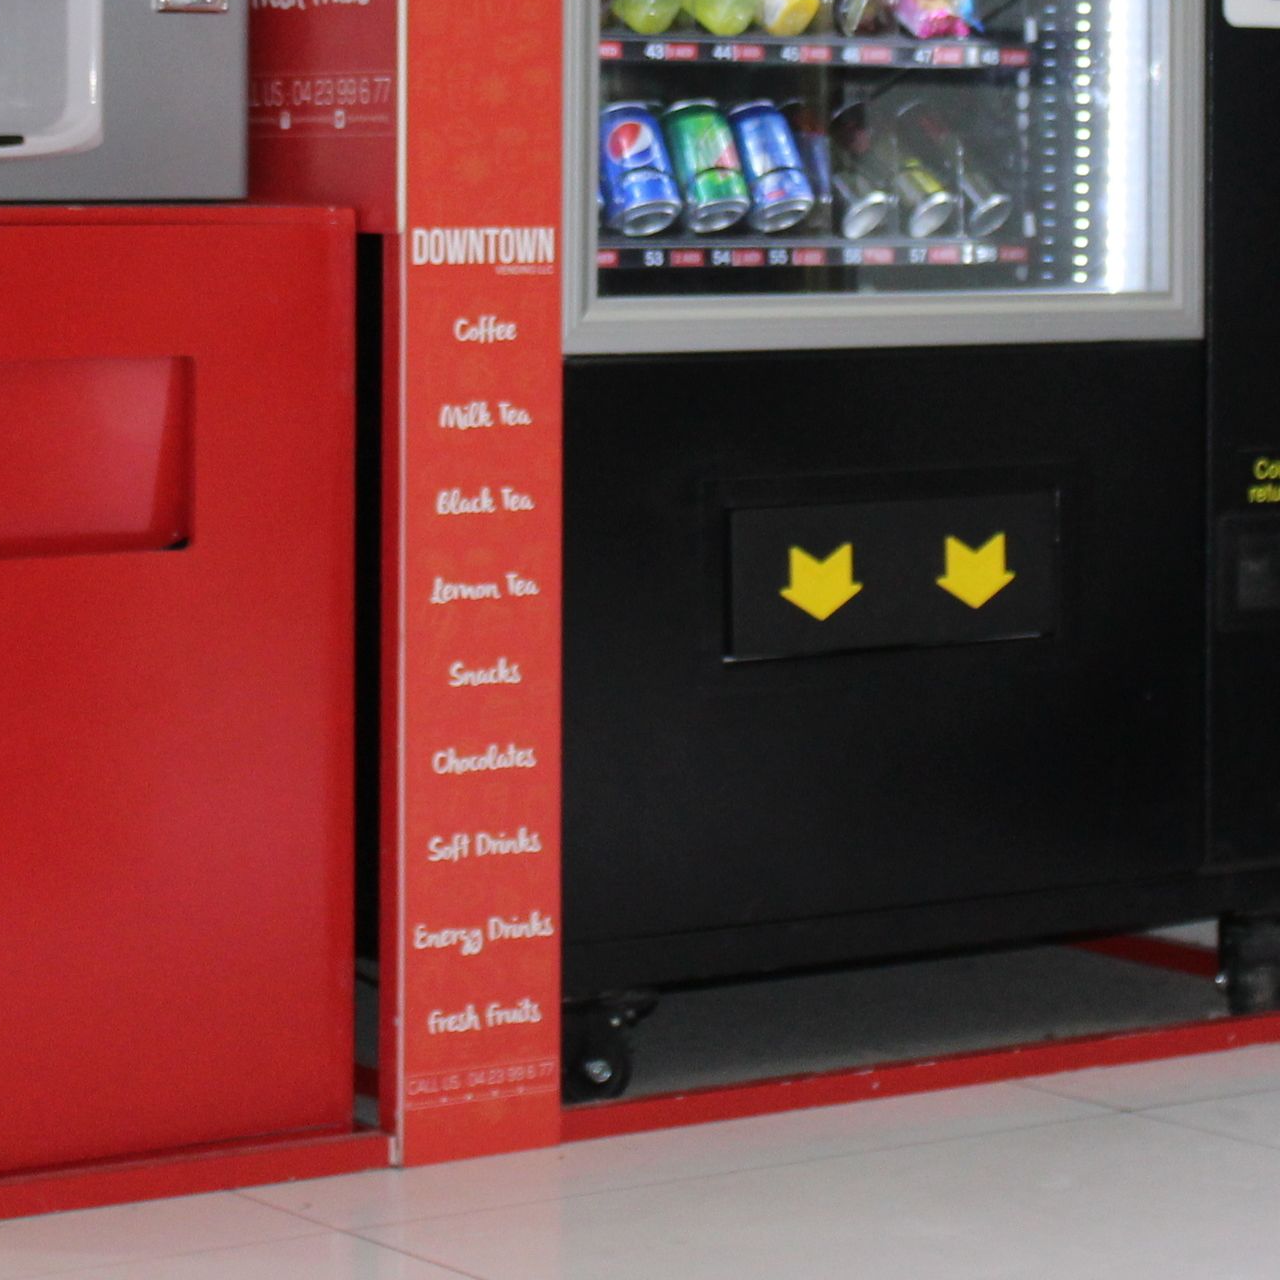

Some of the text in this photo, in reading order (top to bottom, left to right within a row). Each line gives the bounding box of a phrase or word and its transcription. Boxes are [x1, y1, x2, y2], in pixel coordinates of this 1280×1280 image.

[644, 43, 665, 59] 43
[713, 45, 732, 60] 44
[412, 227, 555, 265] DOWNTOWN
[644, 249, 664, 266] 53
[453, 314, 517, 344] Coffee
[439, 401, 532, 430] Milk Tea
[436, 487, 535, 515] Black Tea
[430, 571, 539, 604] Lemon Tea
[448, 657, 522, 688] Snacks
[432, 741, 537, 776] Chocolates
[427, 828, 542, 862] Soft Drinks
[413, 910, 554, 956] Energy Drinks
